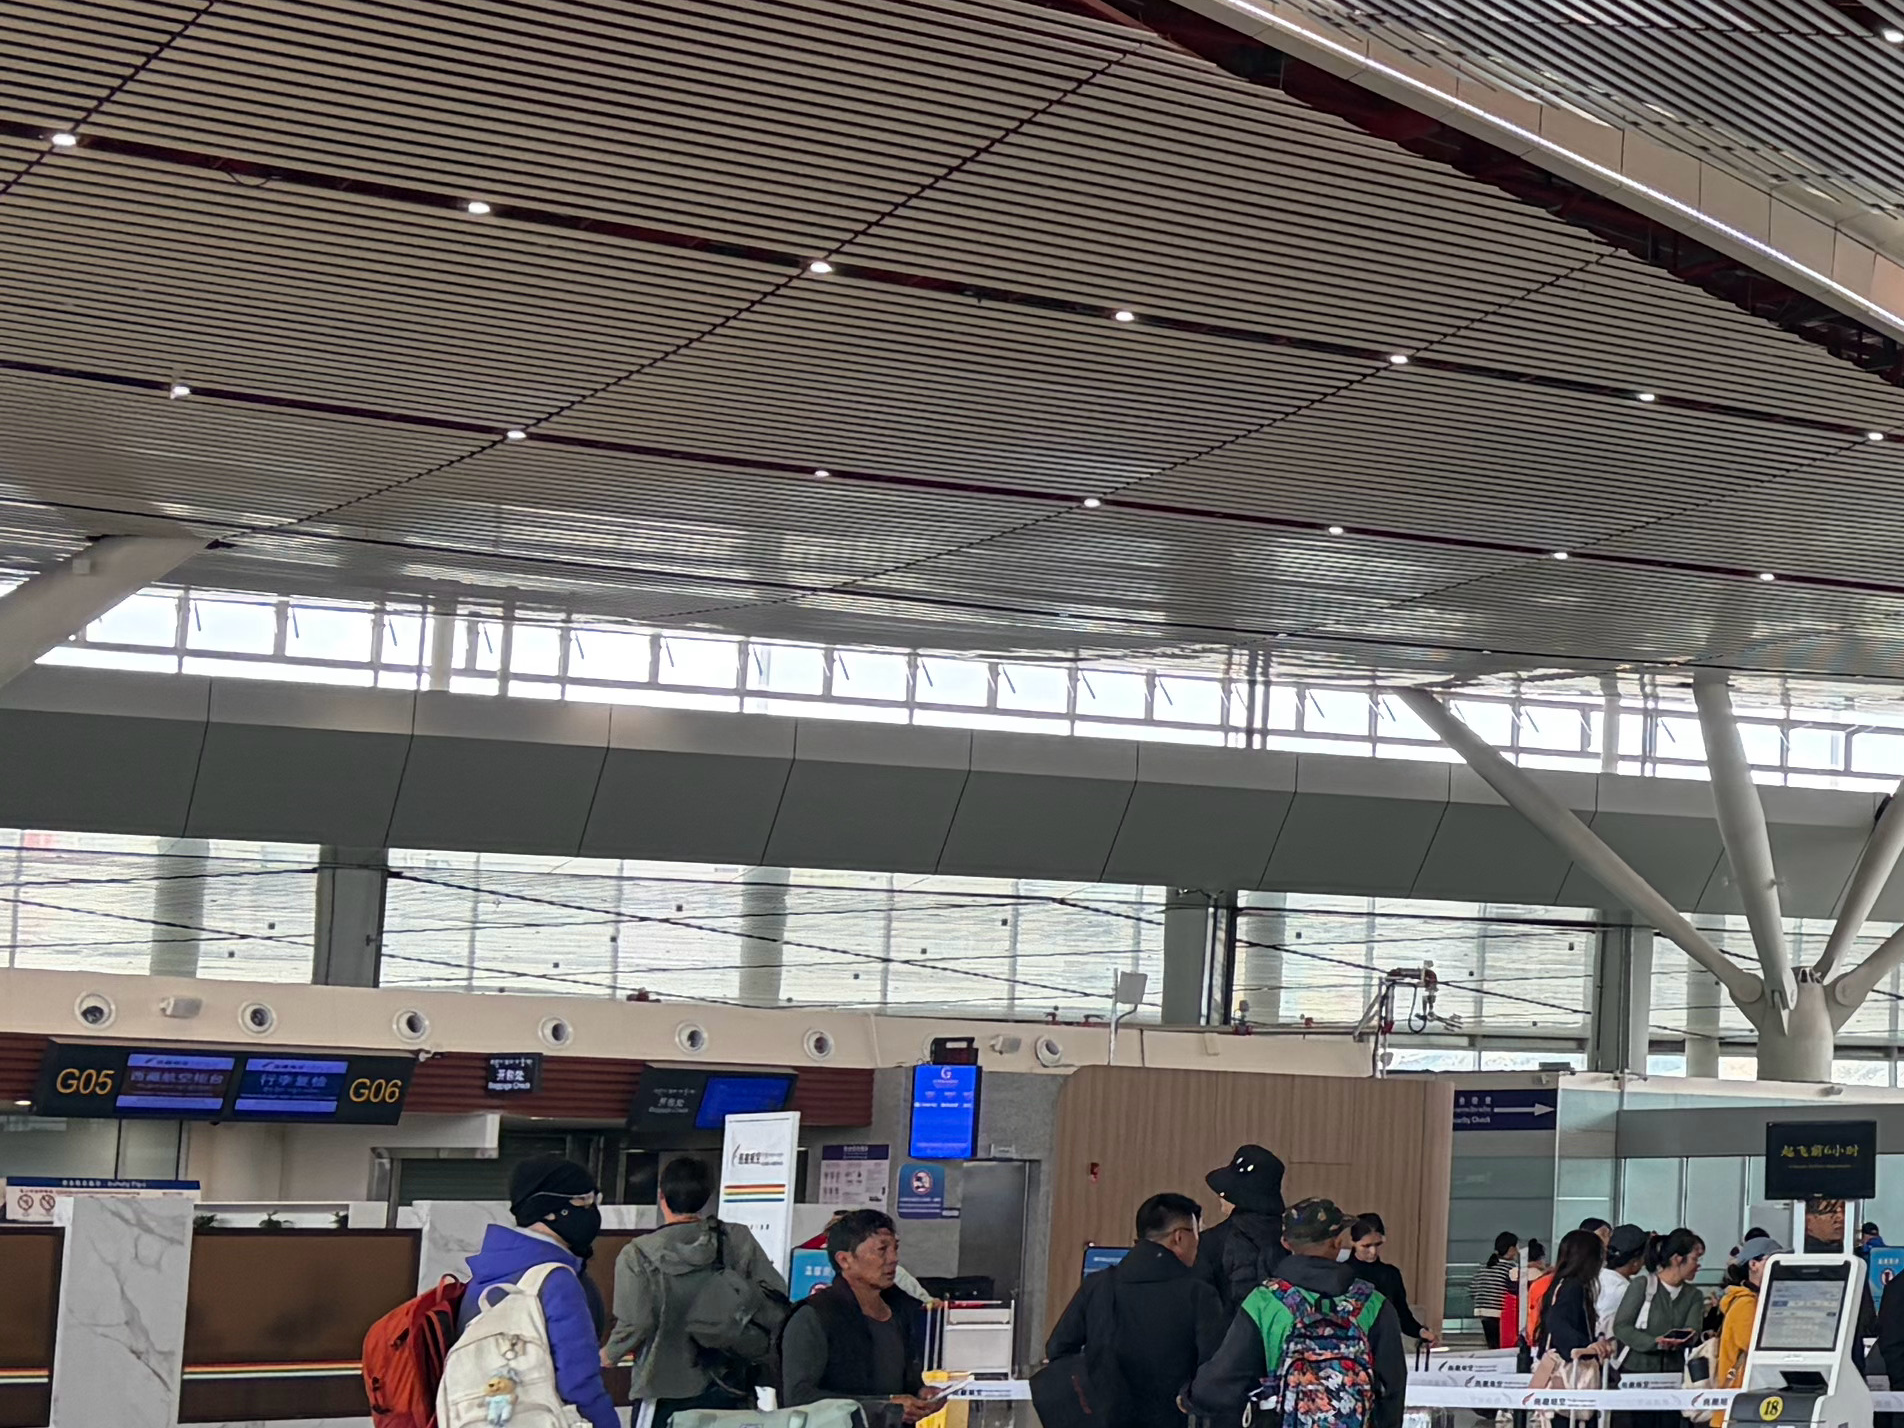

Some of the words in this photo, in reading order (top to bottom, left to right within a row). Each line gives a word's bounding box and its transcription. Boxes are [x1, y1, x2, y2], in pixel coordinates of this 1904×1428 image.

[56, 1068, 114, 1094] G05
[350, 1078, 402, 1102] G06
[1764, 1400, 1778, 1415] 18
